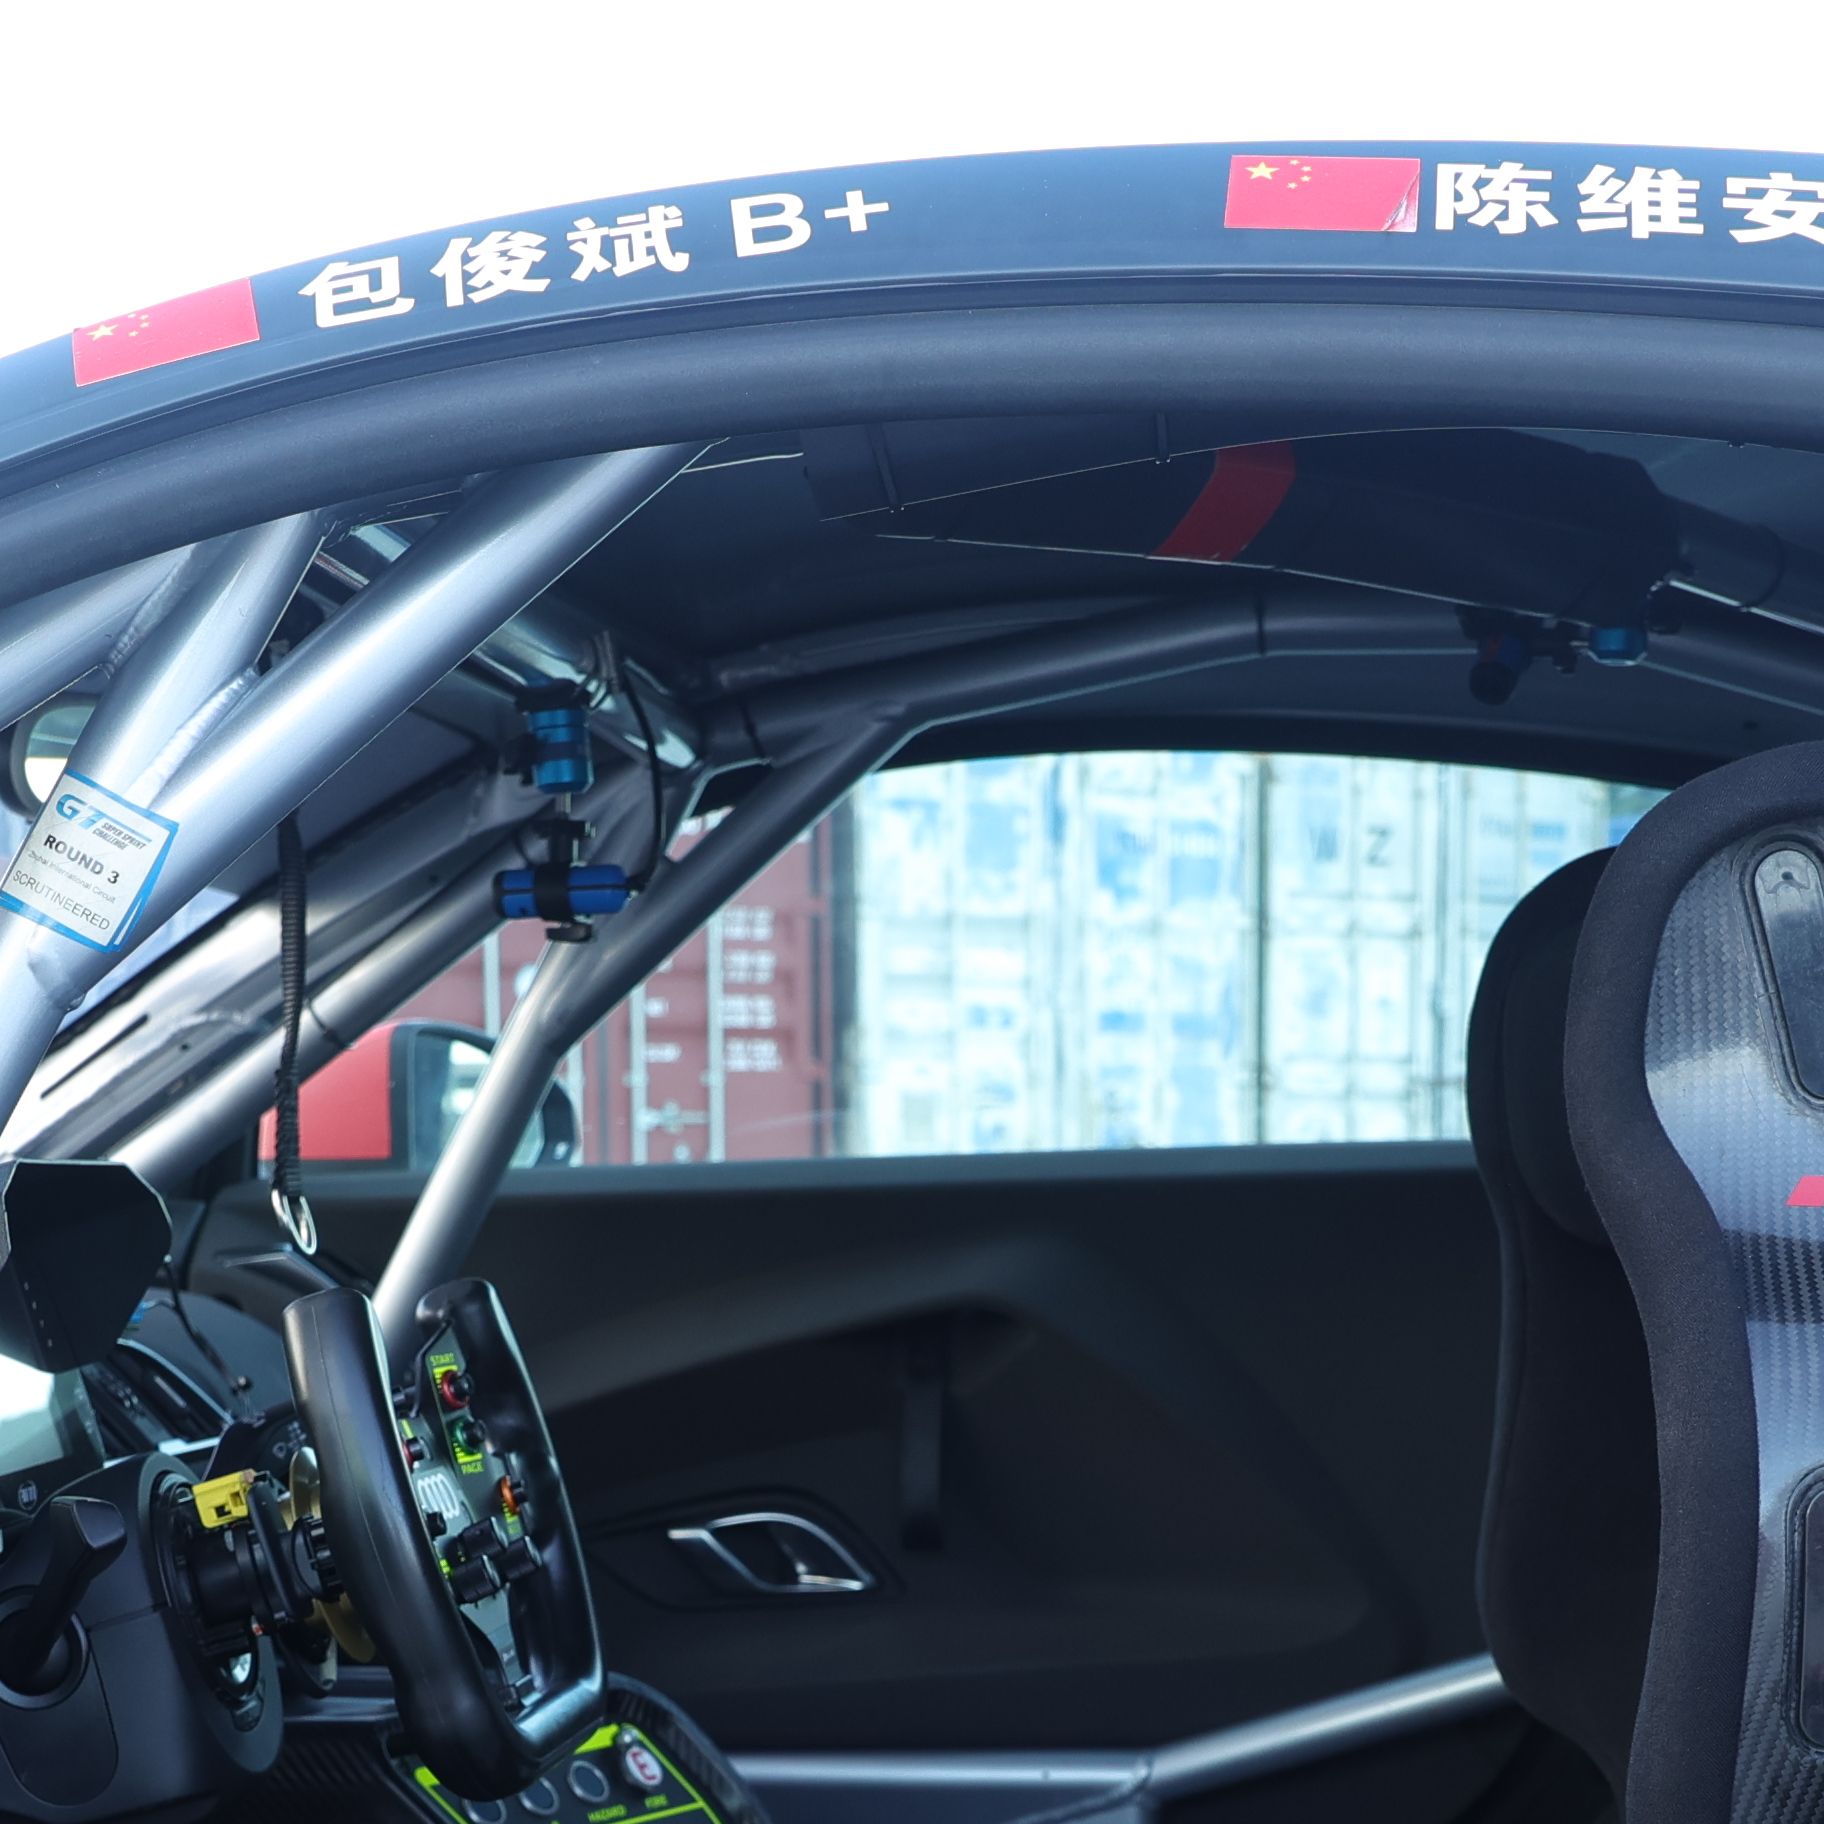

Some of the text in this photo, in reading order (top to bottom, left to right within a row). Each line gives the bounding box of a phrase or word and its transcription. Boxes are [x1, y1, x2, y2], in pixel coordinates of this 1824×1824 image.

[298, 190, 891, 329] 包俊斌 B+
[43, 834, 120, 885] ROUND 3
[12, 870, 110, 931] SCRUTINEERED
[92, 885, 116, 904] Circuit
